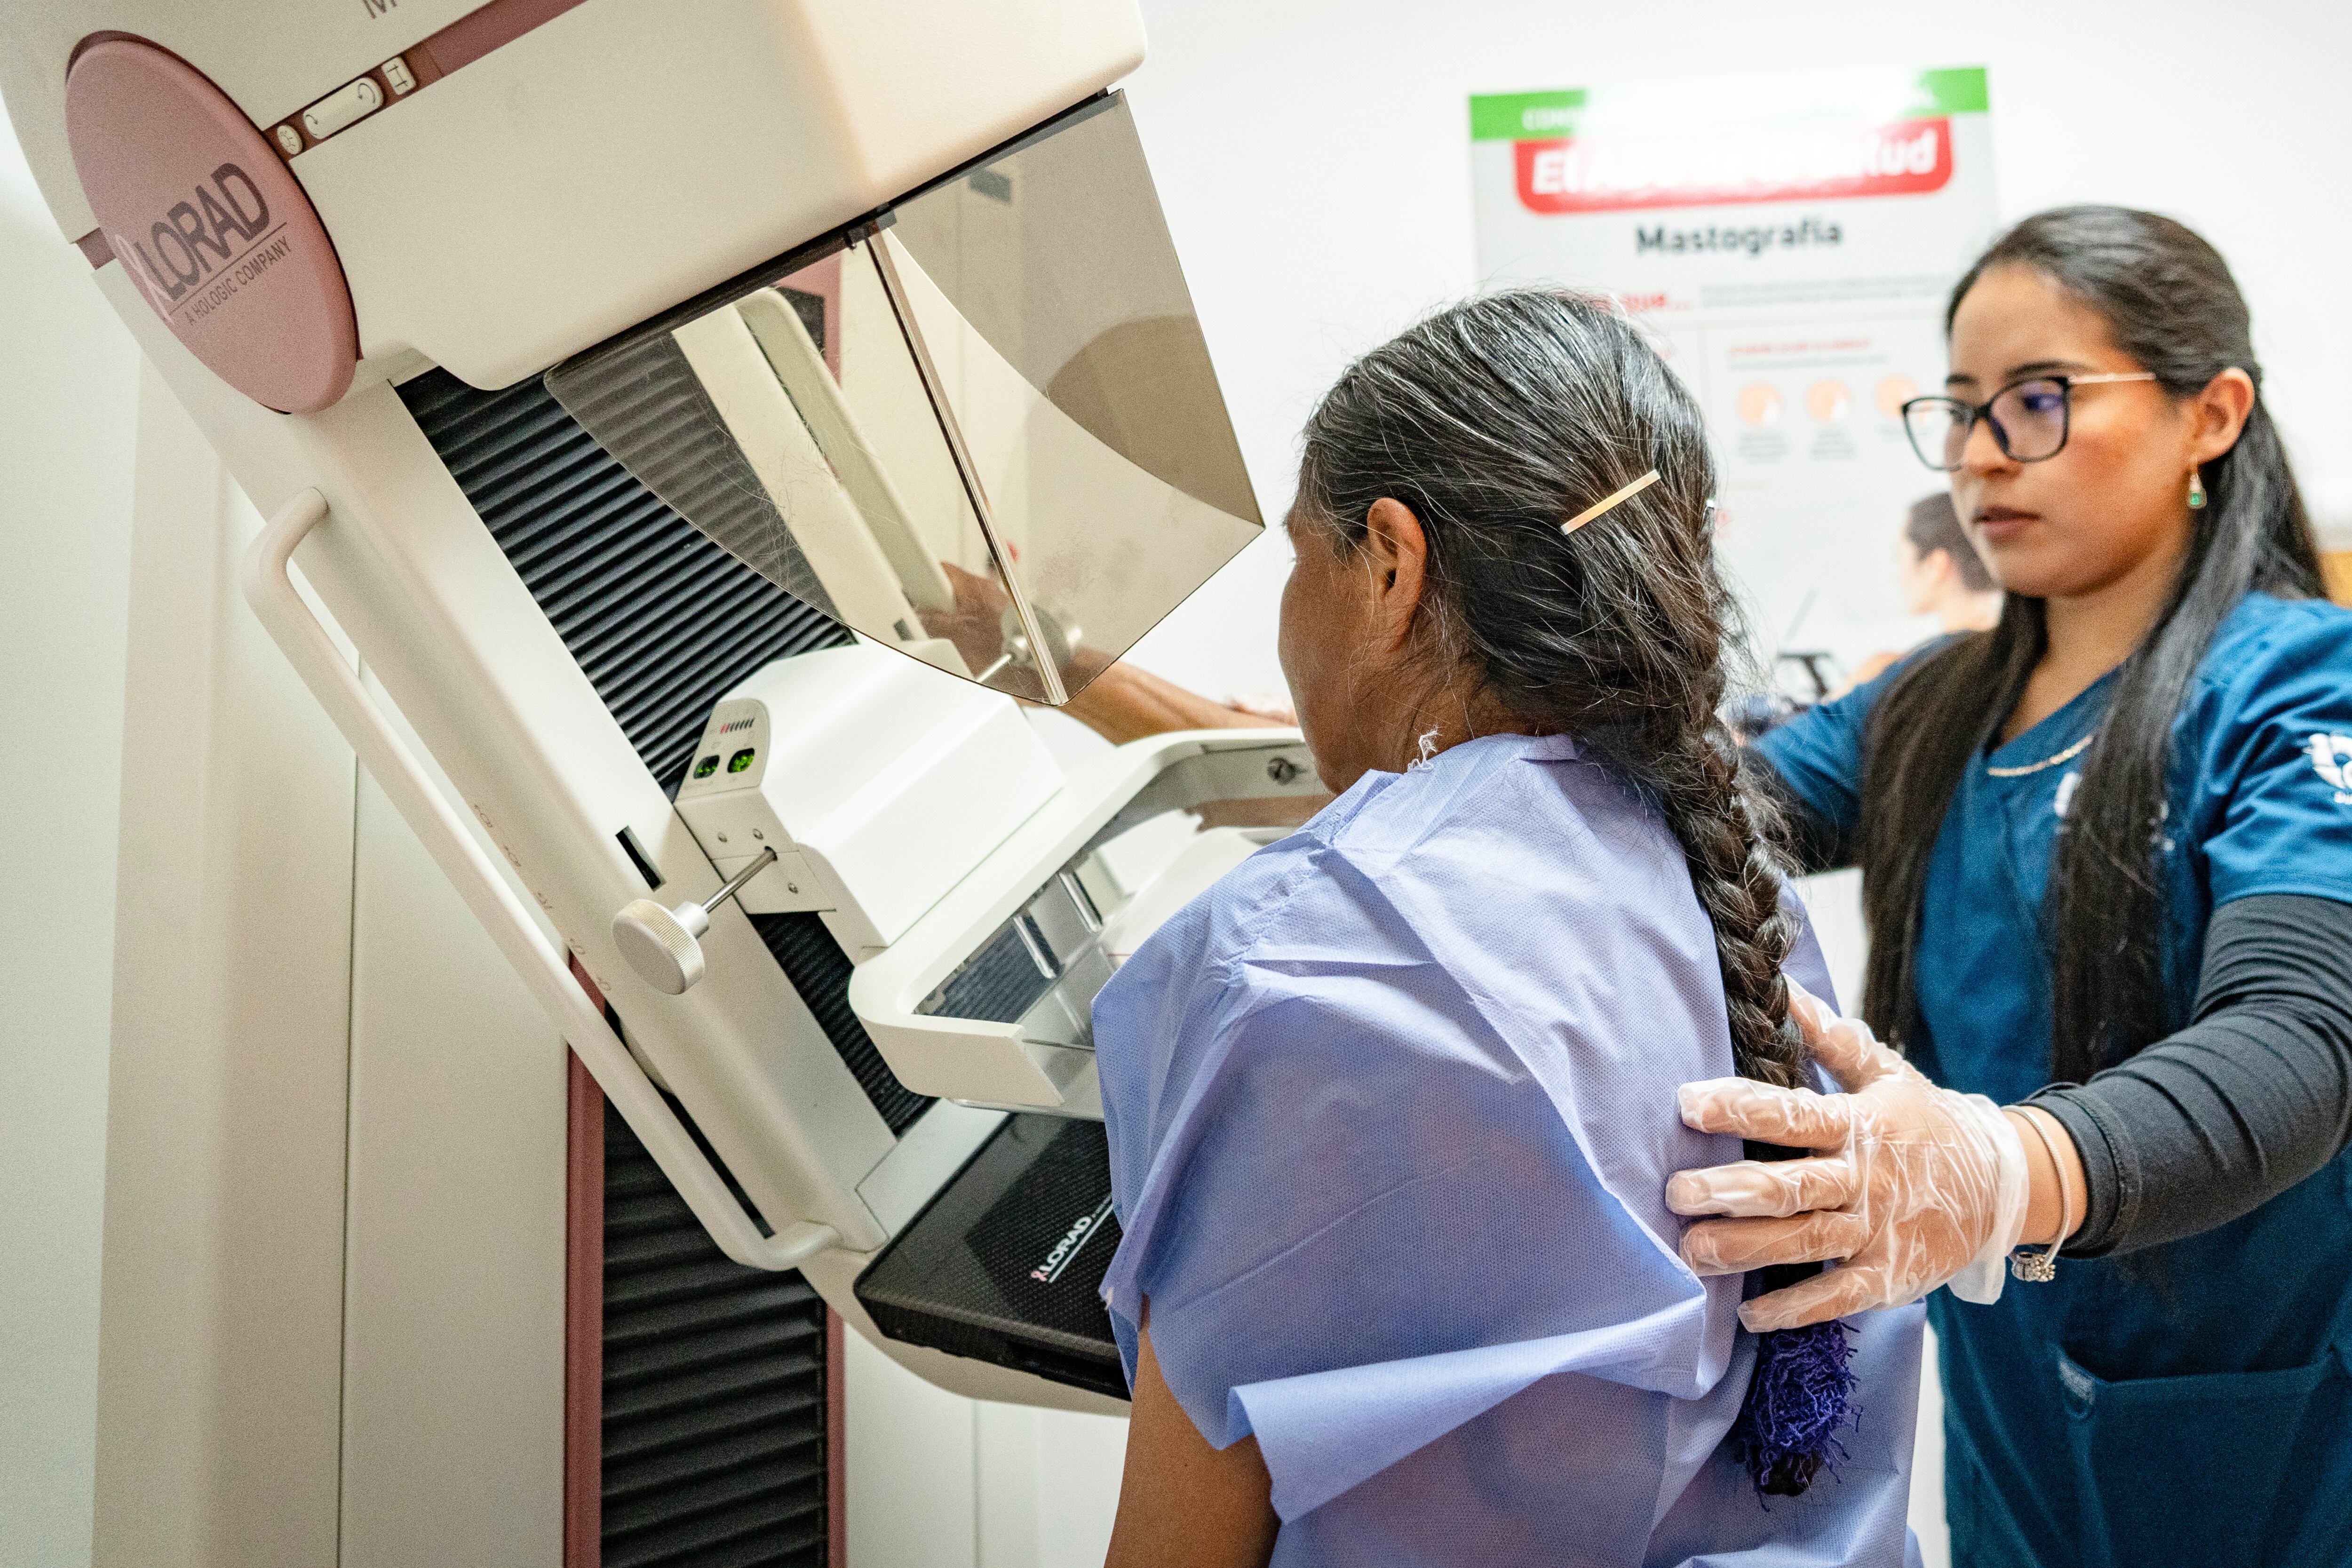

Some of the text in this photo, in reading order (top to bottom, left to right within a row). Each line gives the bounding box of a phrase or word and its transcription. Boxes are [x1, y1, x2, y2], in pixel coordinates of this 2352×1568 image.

[134, 163, 270, 302] LORAD
[184, 236, 291, 326] A HOLOGIC COMPANY
[1038, 1216, 1092, 1272] LORAD
